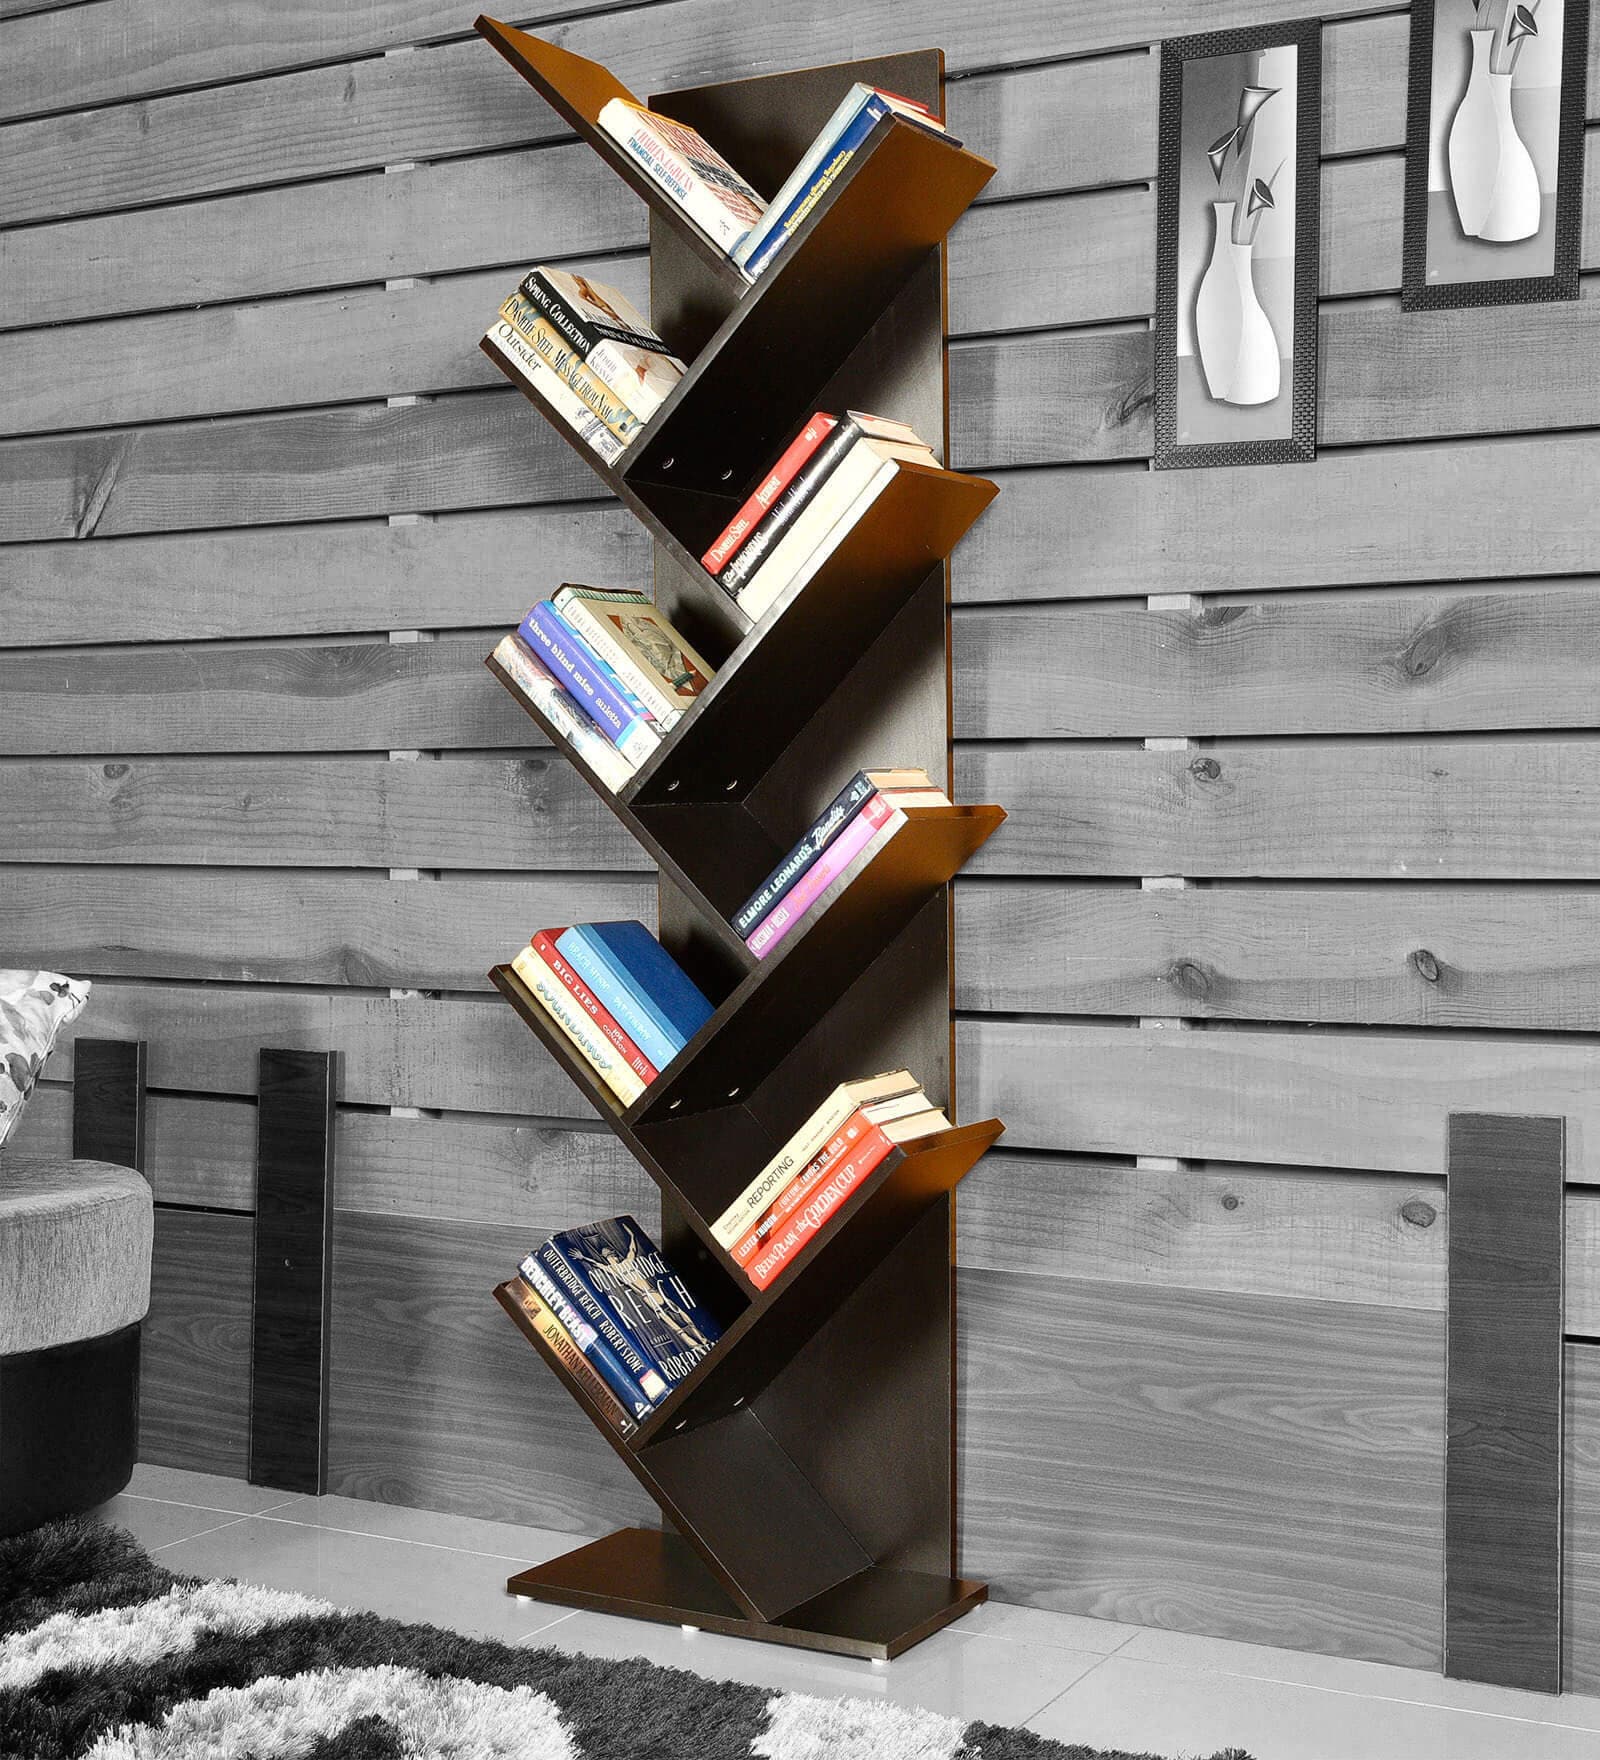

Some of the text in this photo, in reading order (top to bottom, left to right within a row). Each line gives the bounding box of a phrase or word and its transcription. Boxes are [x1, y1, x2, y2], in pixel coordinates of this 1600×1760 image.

[627, 137, 654, 169] FINANCIAL
[525, 277, 594, 354] SPRING COLLECTION
[498, 323, 542, 370] Outsider
[504, 299, 536, 334] DANIELLE
[531, 327, 554, 359] STEEL
[553, 348, 582, 389] MESSAGE
[529, 619, 595, 696] three blind mice
[812, 804, 846, 850] Bandits
[739, 890, 773, 929] ELMORE
[771, 844, 814, 893] LEONARD'S
[553, 960, 599, 1015] BIG LIES
[612, 1027, 624, 1043] JOE
[747, 1155, 795, 1209] REPORTING
[775, 1231, 799, 1259] PLAIN
[806, 1182, 842, 1227] GOLDEN
[835, 1164, 857, 1196] CUP
[588, 1251, 670, 1294] OUTERBRIDGE
[738, 1236, 759, 1257] LESTER
[521, 1257, 567, 1315] BENCHLEY
[558, 1303, 593, 1345] BEAST
[543, 1250, 603, 1320] OUTERBRIDGE REACH
[608, 1275, 697, 1330] REACH
[543, 1325, 583, 1369] JONATHAN
[599, 1320, 645, 1374] ROBERT STONE
[660, 1350, 705, 1382] ROBERT
